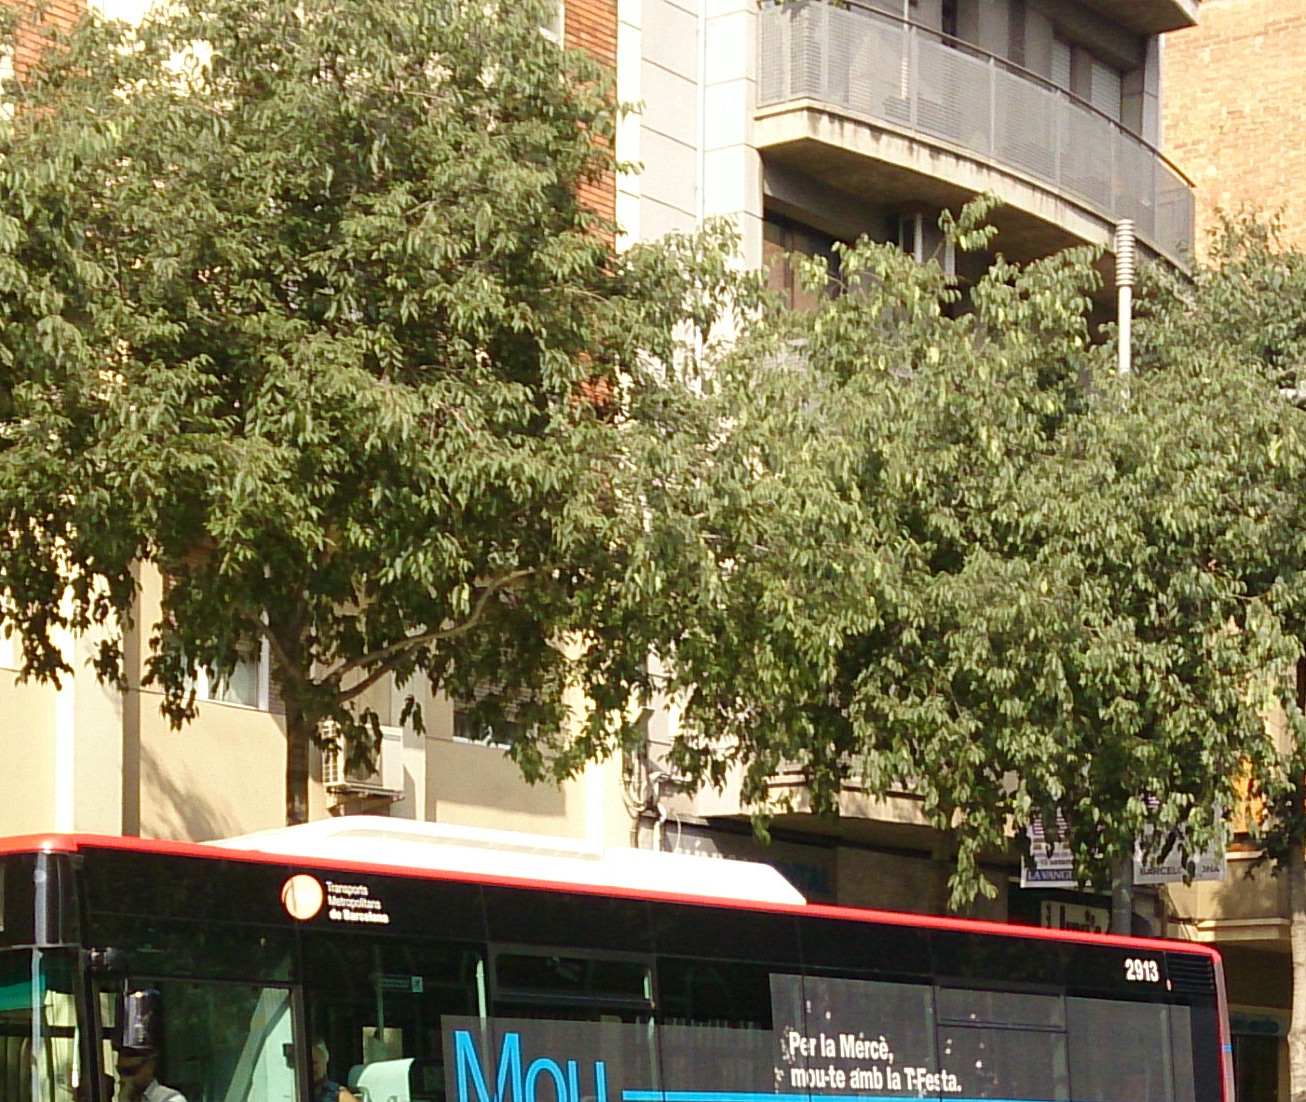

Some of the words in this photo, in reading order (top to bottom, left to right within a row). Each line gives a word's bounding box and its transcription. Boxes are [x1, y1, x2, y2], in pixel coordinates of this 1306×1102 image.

[329, 908, 342, 921] de
[343, 909, 390, 923] Barcelona
[1124, 958, 1159, 983] 2913
[789, 1031, 817, 1058] Per
[820, 1033, 836, 1058] la
[839, 1033, 894, 1064] Mercè,
[790, 1065, 846, 1089] mou-te
[850, 1065, 883, 1090] amb
[887, 1066, 902, 1090] la
[904, 1066, 963, 1092] T-Festa.
